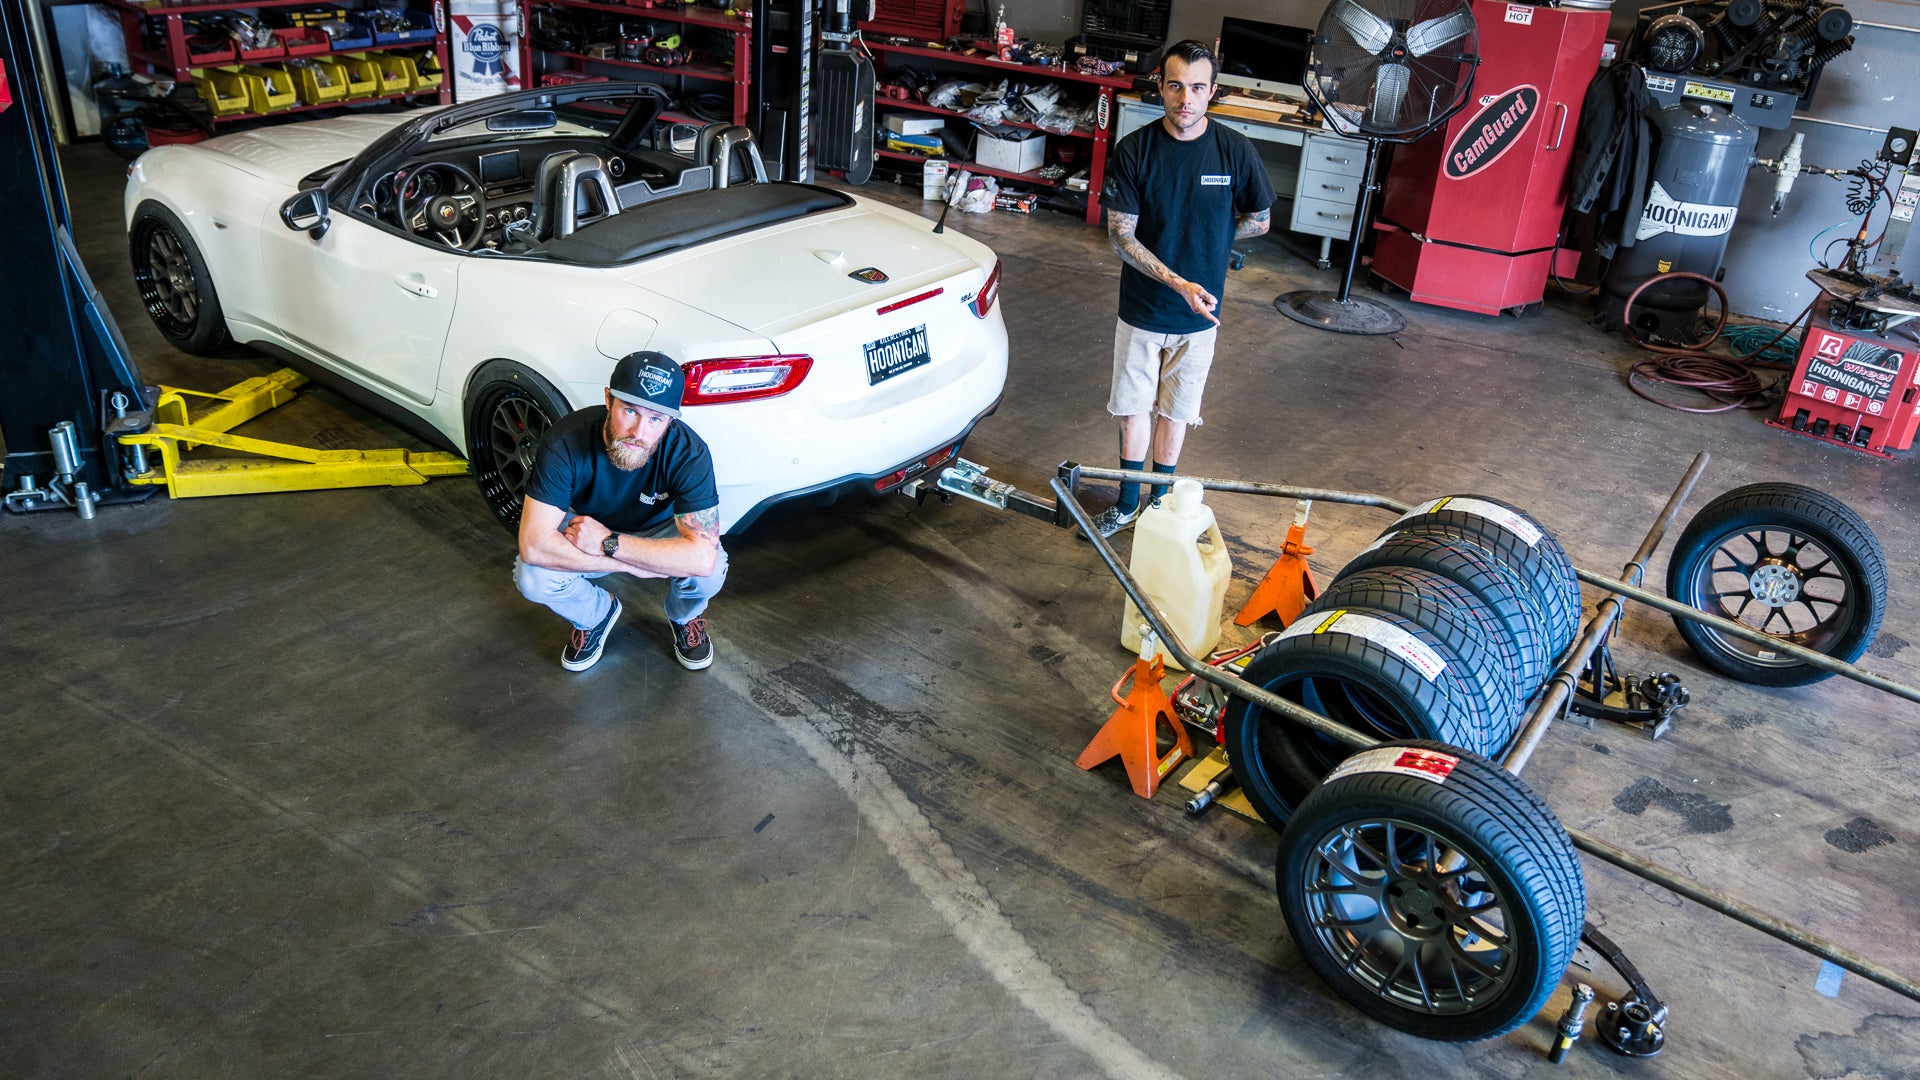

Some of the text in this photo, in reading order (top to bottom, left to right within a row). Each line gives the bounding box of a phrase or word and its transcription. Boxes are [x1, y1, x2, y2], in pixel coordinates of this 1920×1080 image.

[1509, 12, 1530, 22] HOT
[473, 28, 498, 41] Pabst
[463, 41, 510, 53] Blue Ribbon
[1100, 95, 1108, 128] Ranger
[1453, 92, 1528, 173] CamGuard
